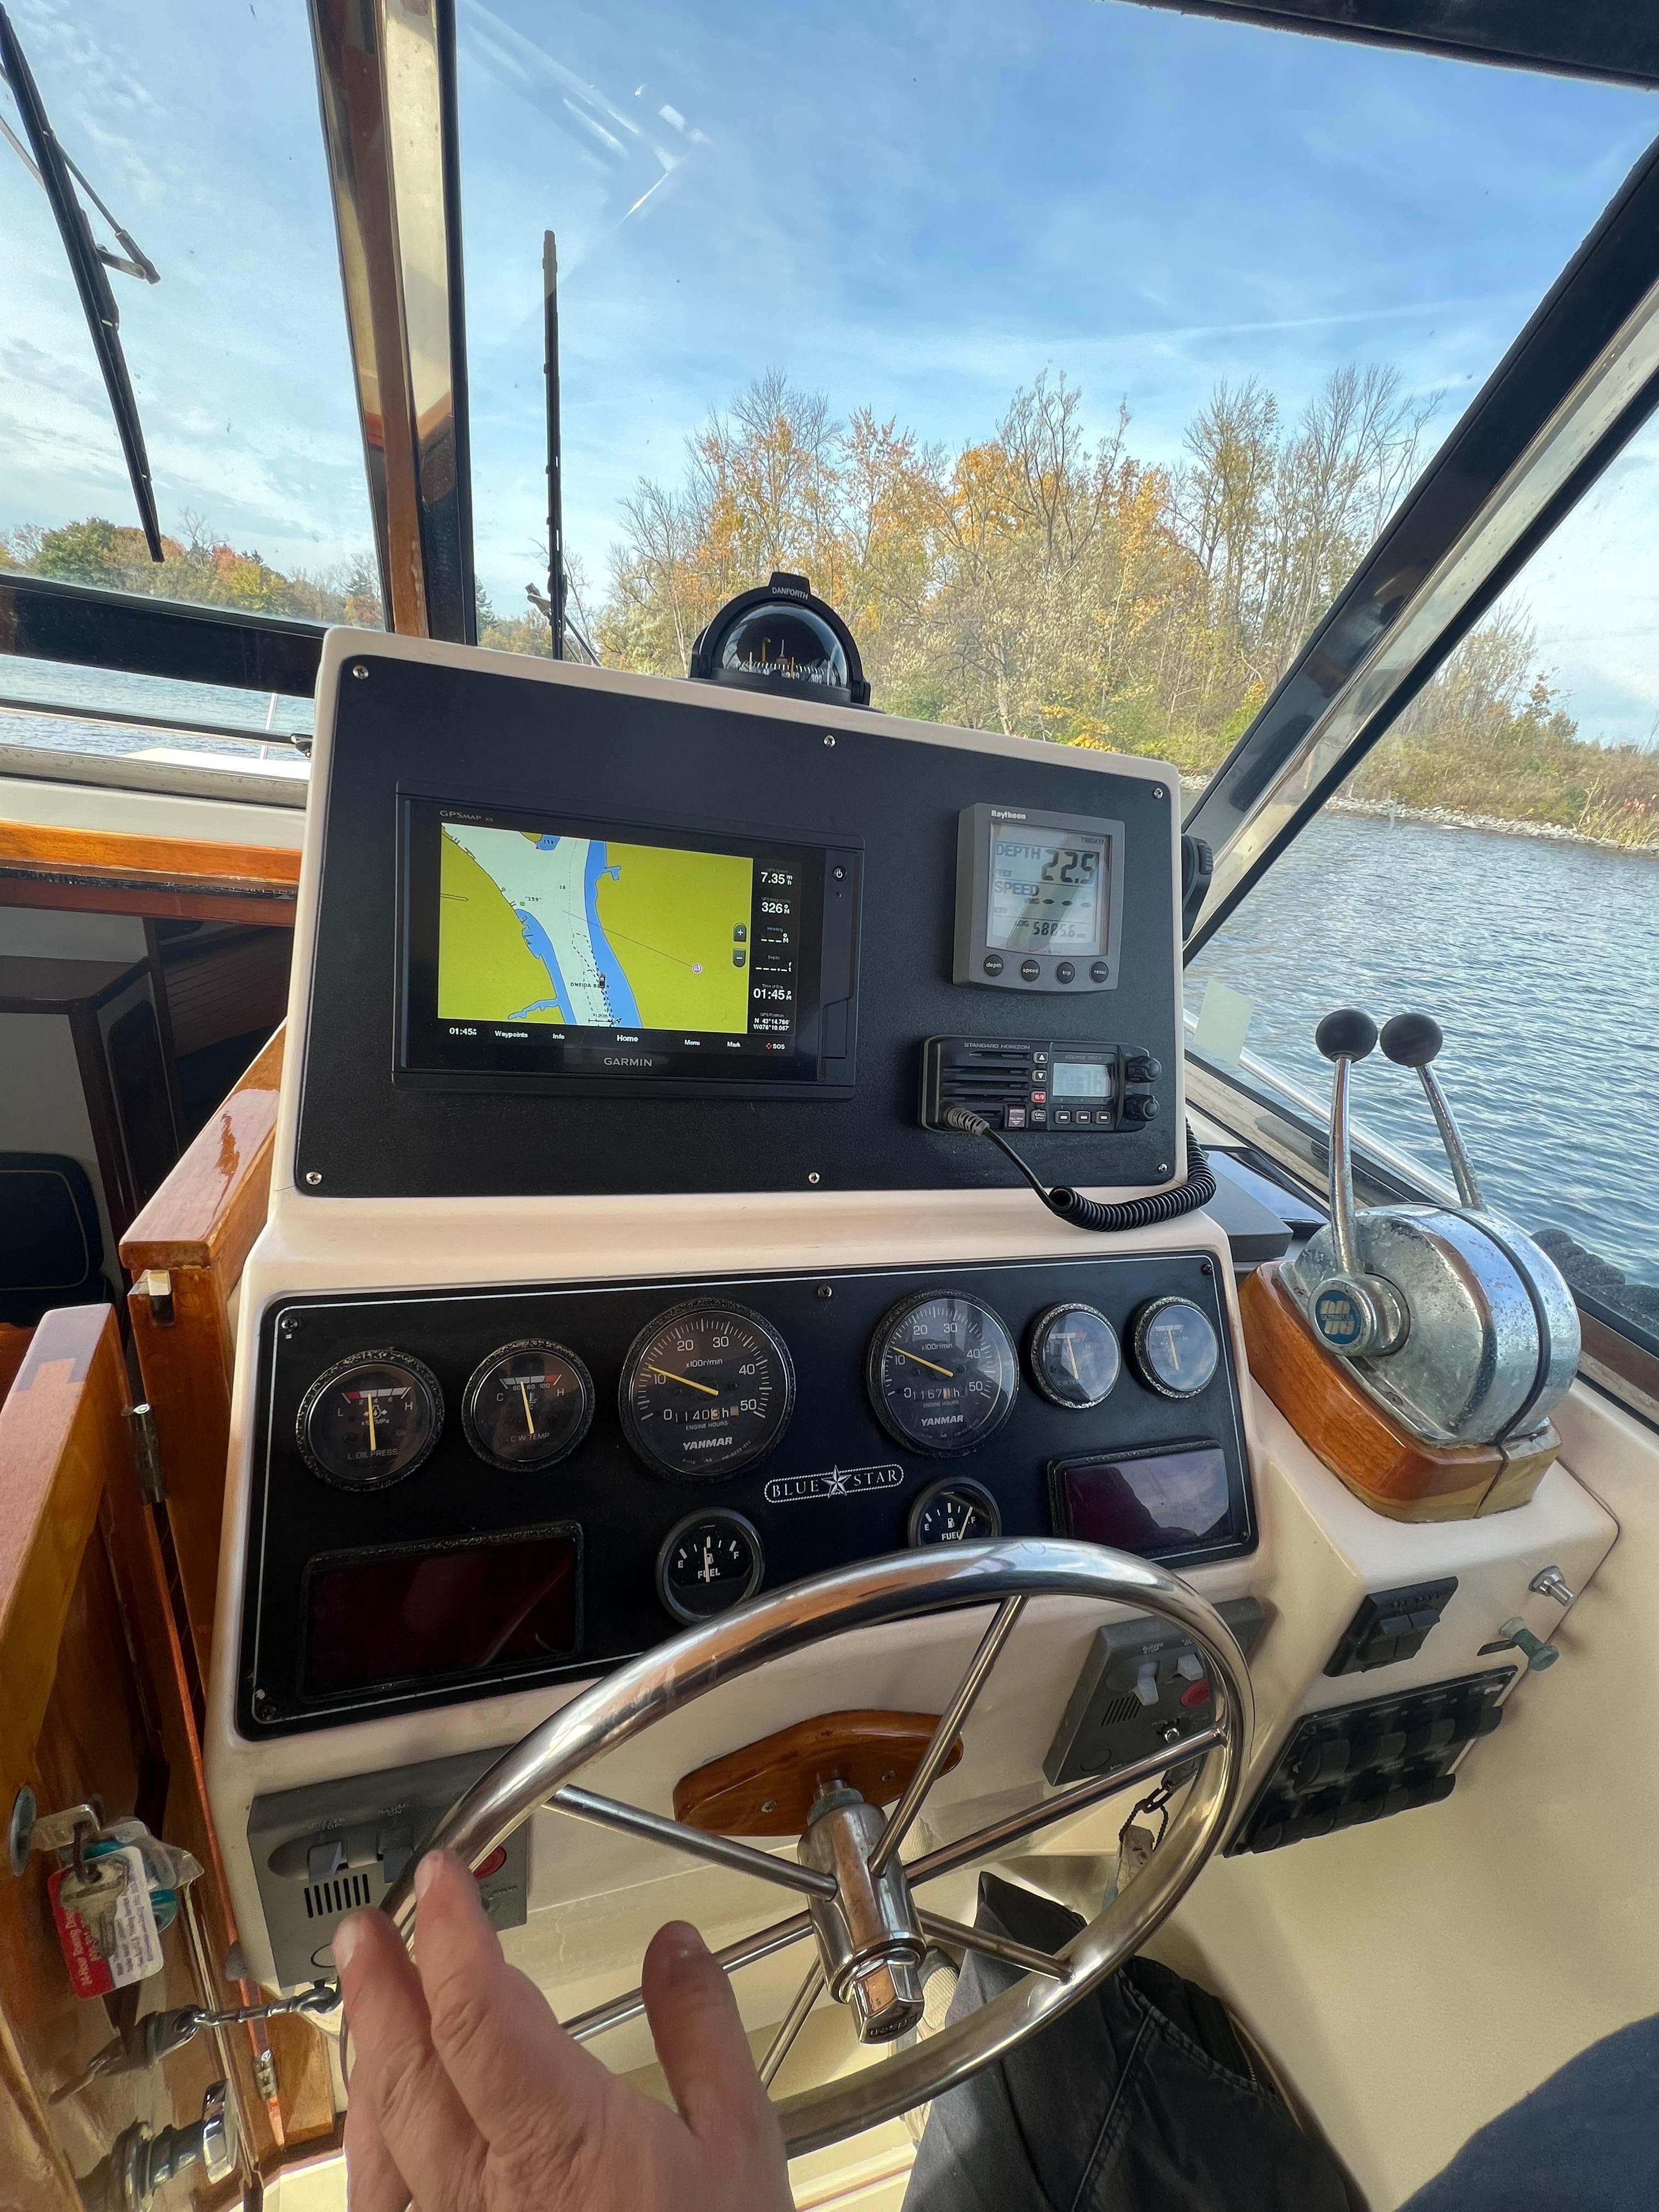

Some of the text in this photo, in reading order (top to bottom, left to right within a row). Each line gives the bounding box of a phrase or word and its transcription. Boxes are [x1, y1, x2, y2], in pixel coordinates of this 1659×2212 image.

[771, 586, 809, 600] DANFORTH
[439, 810, 482, 820] GPSMAP
[991, 810, 1026, 820] Raytheon
[996, 843, 1041, 860] DEPTH
[761, 872, 785, 884] 7.35
[995, 881, 1040, 896] SPEED
[761, 901, 783, 913] 326
[753, 988, 785, 1000] 01:45
[603, 1058, 653, 1066] GARMIN
[913, 1323, 957, 1335] 20 30
[677, 1336, 729, 1351] 20 30
[966, 1348, 980, 1359] 40
[686, 1359, 723, 1368] x100r/min
[895, 1355, 905, 1365] 10
[738, 1364, 755, 1375] 40
[654, 1374, 666, 1385] 10
[557, 1388, 565, 1396] H
[969, 1381, 983, 1392] 50
[496, 1393, 504, 1402] C
[405, 1402, 413, 1410] H
[741, 1399, 757, 1411] 50
[337, 1408, 344, 1417] L
[921, 1415, 963, 1426] YANMAR
[529, 1432, 550, 1441] TEMP
[682, 1437, 733, 1451] YANMAR
[772, 1469, 898, 1497] BLUE STAR
[941, 1531, 961, 1541] FUEL
[733, 1551, 739, 1559] F
[678, 1560, 684, 1568] E
